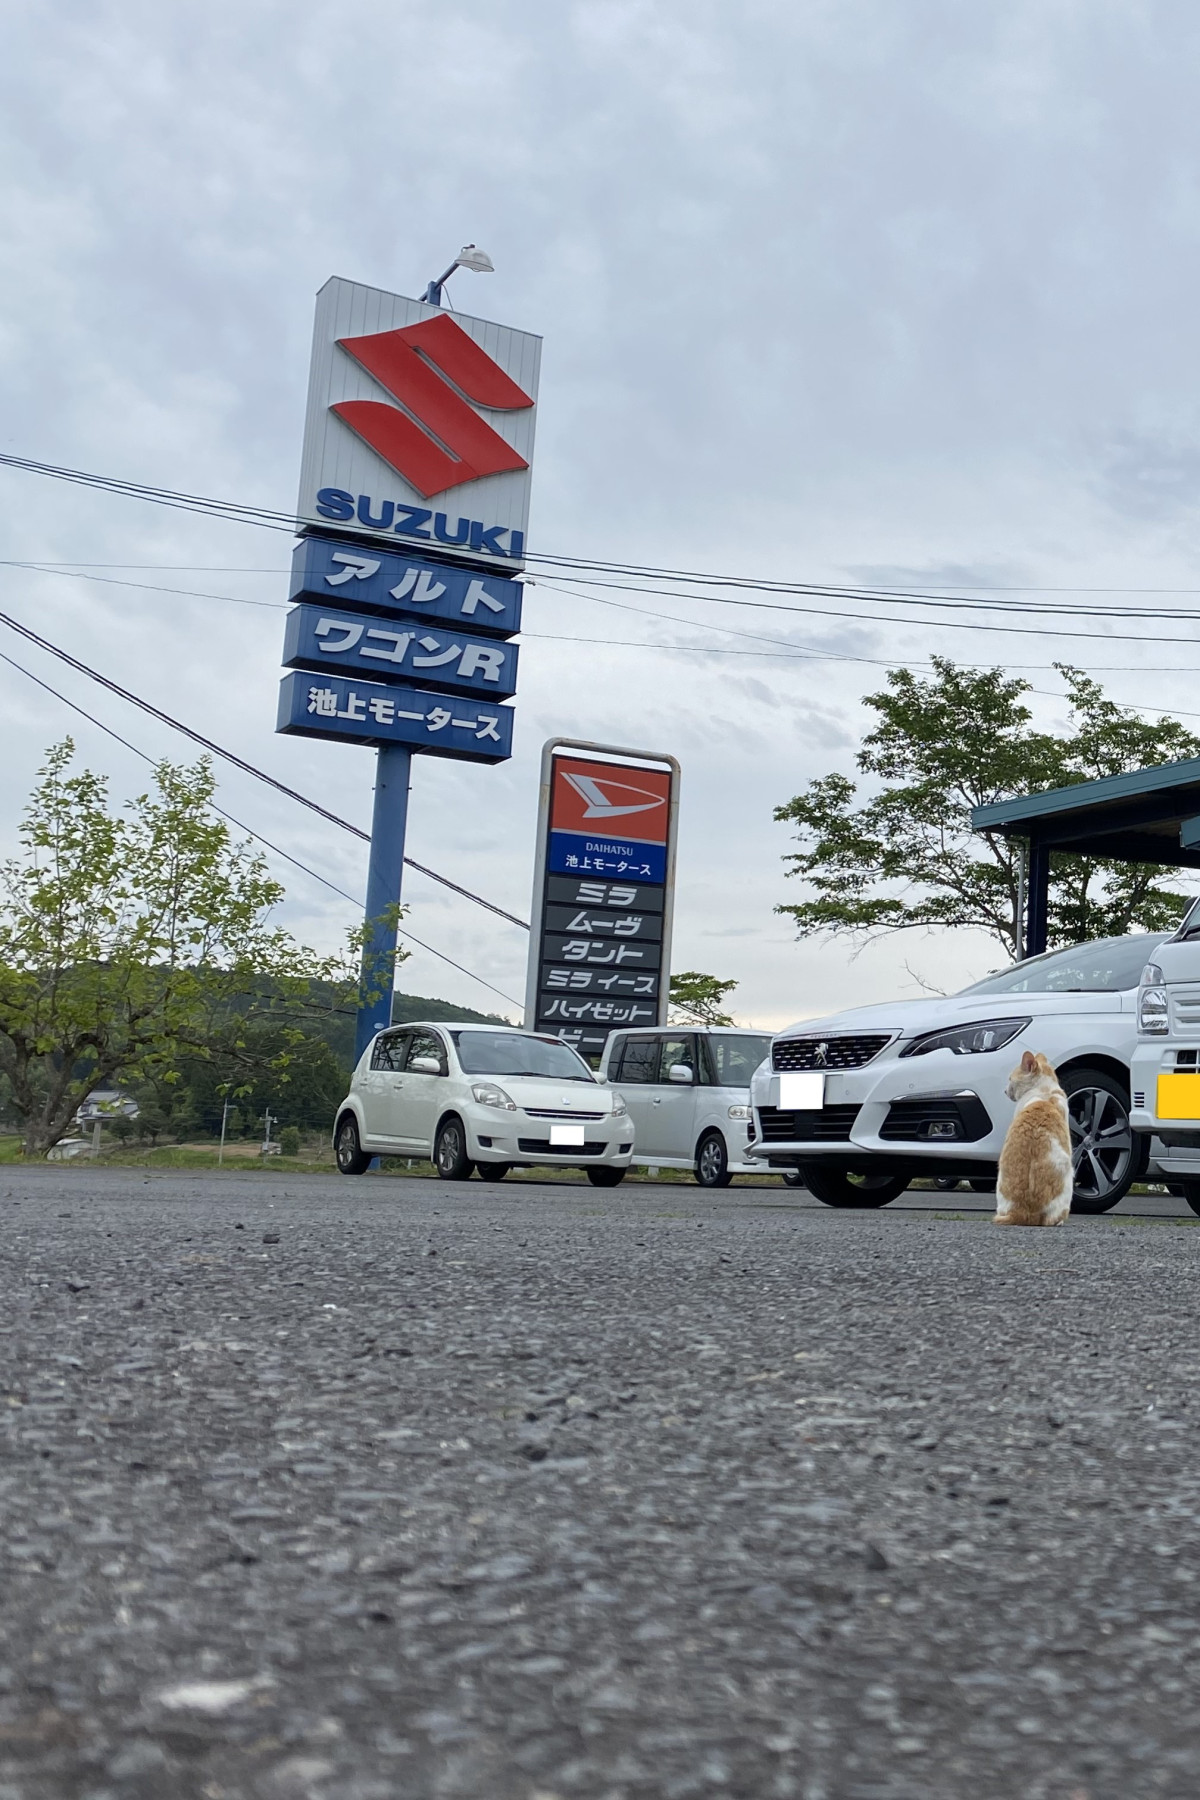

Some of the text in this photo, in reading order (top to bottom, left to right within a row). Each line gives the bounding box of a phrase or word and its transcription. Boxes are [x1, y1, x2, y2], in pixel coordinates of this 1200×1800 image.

[316, 488, 524, 558] SUZUKI
[324, 552, 506, 615] アルト
[314, 617, 506, 682] ワゴンR
[307, 686, 501, 742] 池上モータース
[585, 842, 634, 856] DAIHATSU
[565, 854, 651, 875] 池上モータース
[576, 882, 638, 906] ミラ
[565, 911, 643, 936] ムーヴ
[561, 940, 644, 964] タント
[544, 999, 653, 1022] ハイゼット
[558, 1028, 605, 1050] ビー
